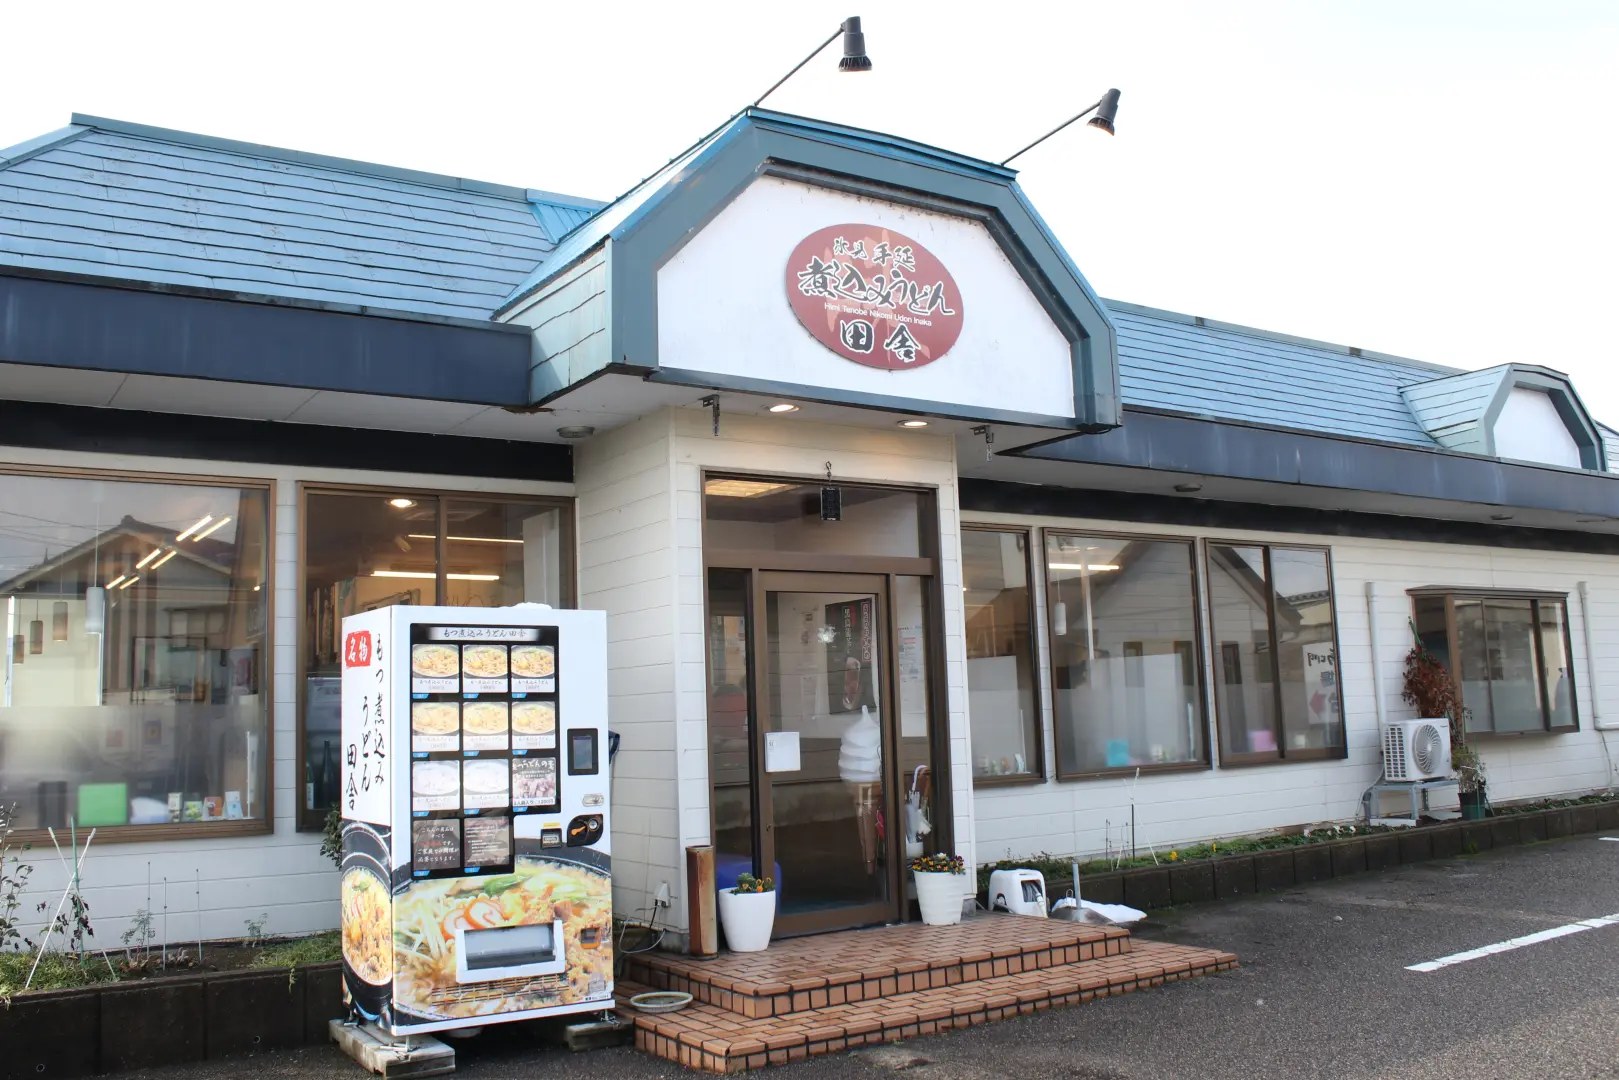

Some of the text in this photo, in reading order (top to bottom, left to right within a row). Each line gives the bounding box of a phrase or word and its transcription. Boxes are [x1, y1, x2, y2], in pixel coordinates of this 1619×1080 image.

[833, 237, 916, 272] 氷見 手延
[797, 256, 956, 316] 煮込みうどん
[824, 303, 840, 311] Himi
[869, 310, 893, 320] Nikomi
[894, 314, 912, 323] Udon
[913, 316, 932, 327] Inaka
[840, 319, 922, 363] 田舎
[347, 635, 368, 663] 名物
[373, 633, 386, 785] もつ煮込み
[361, 695, 372, 792] うどん
[345, 743, 358, 811] 田舎
